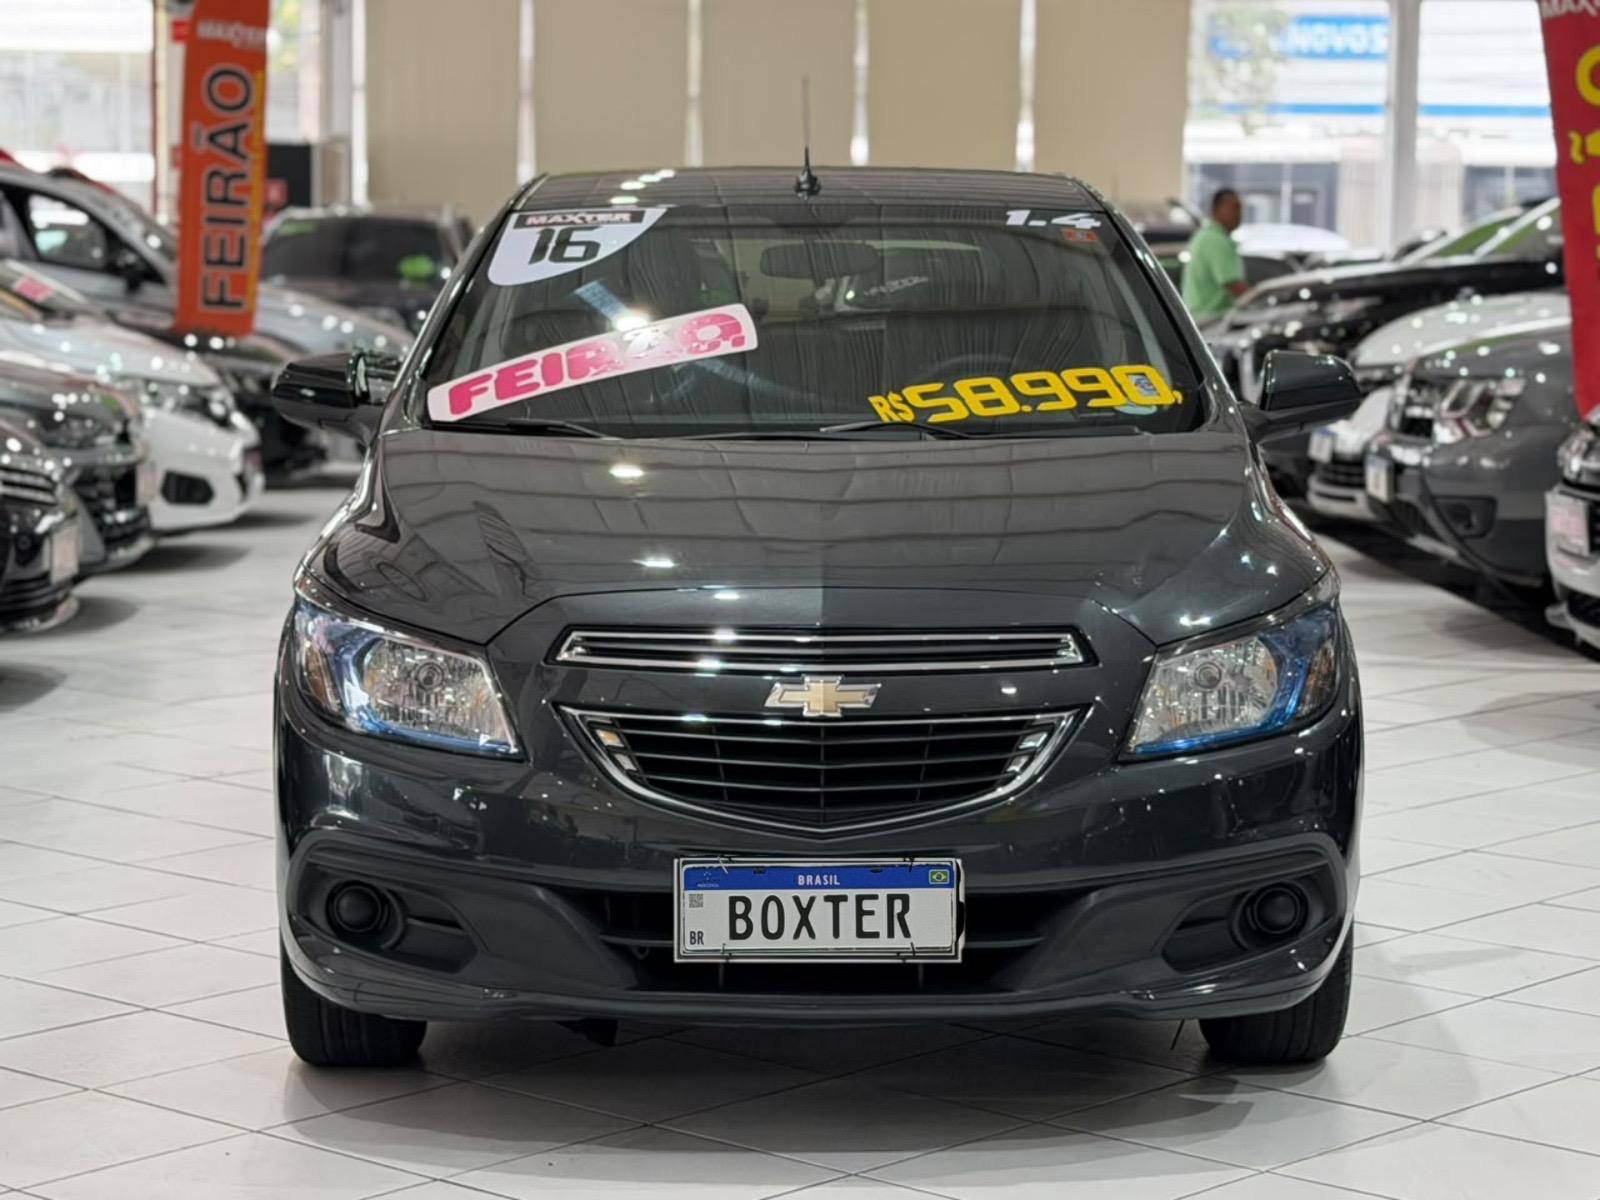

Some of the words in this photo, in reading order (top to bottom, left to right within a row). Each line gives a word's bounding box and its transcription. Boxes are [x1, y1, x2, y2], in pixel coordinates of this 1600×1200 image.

[192, 64, 254, 311] FEIRÃO
[526, 212, 632, 226] MAXTER
[1005, 209, 1102, 230] 1.4
[528, 226, 604, 265] 16
[797, 874, 841, 886] BRASIL
[728, 893, 912, 941] BOXTER
[689, 930, 704, 946] BR
